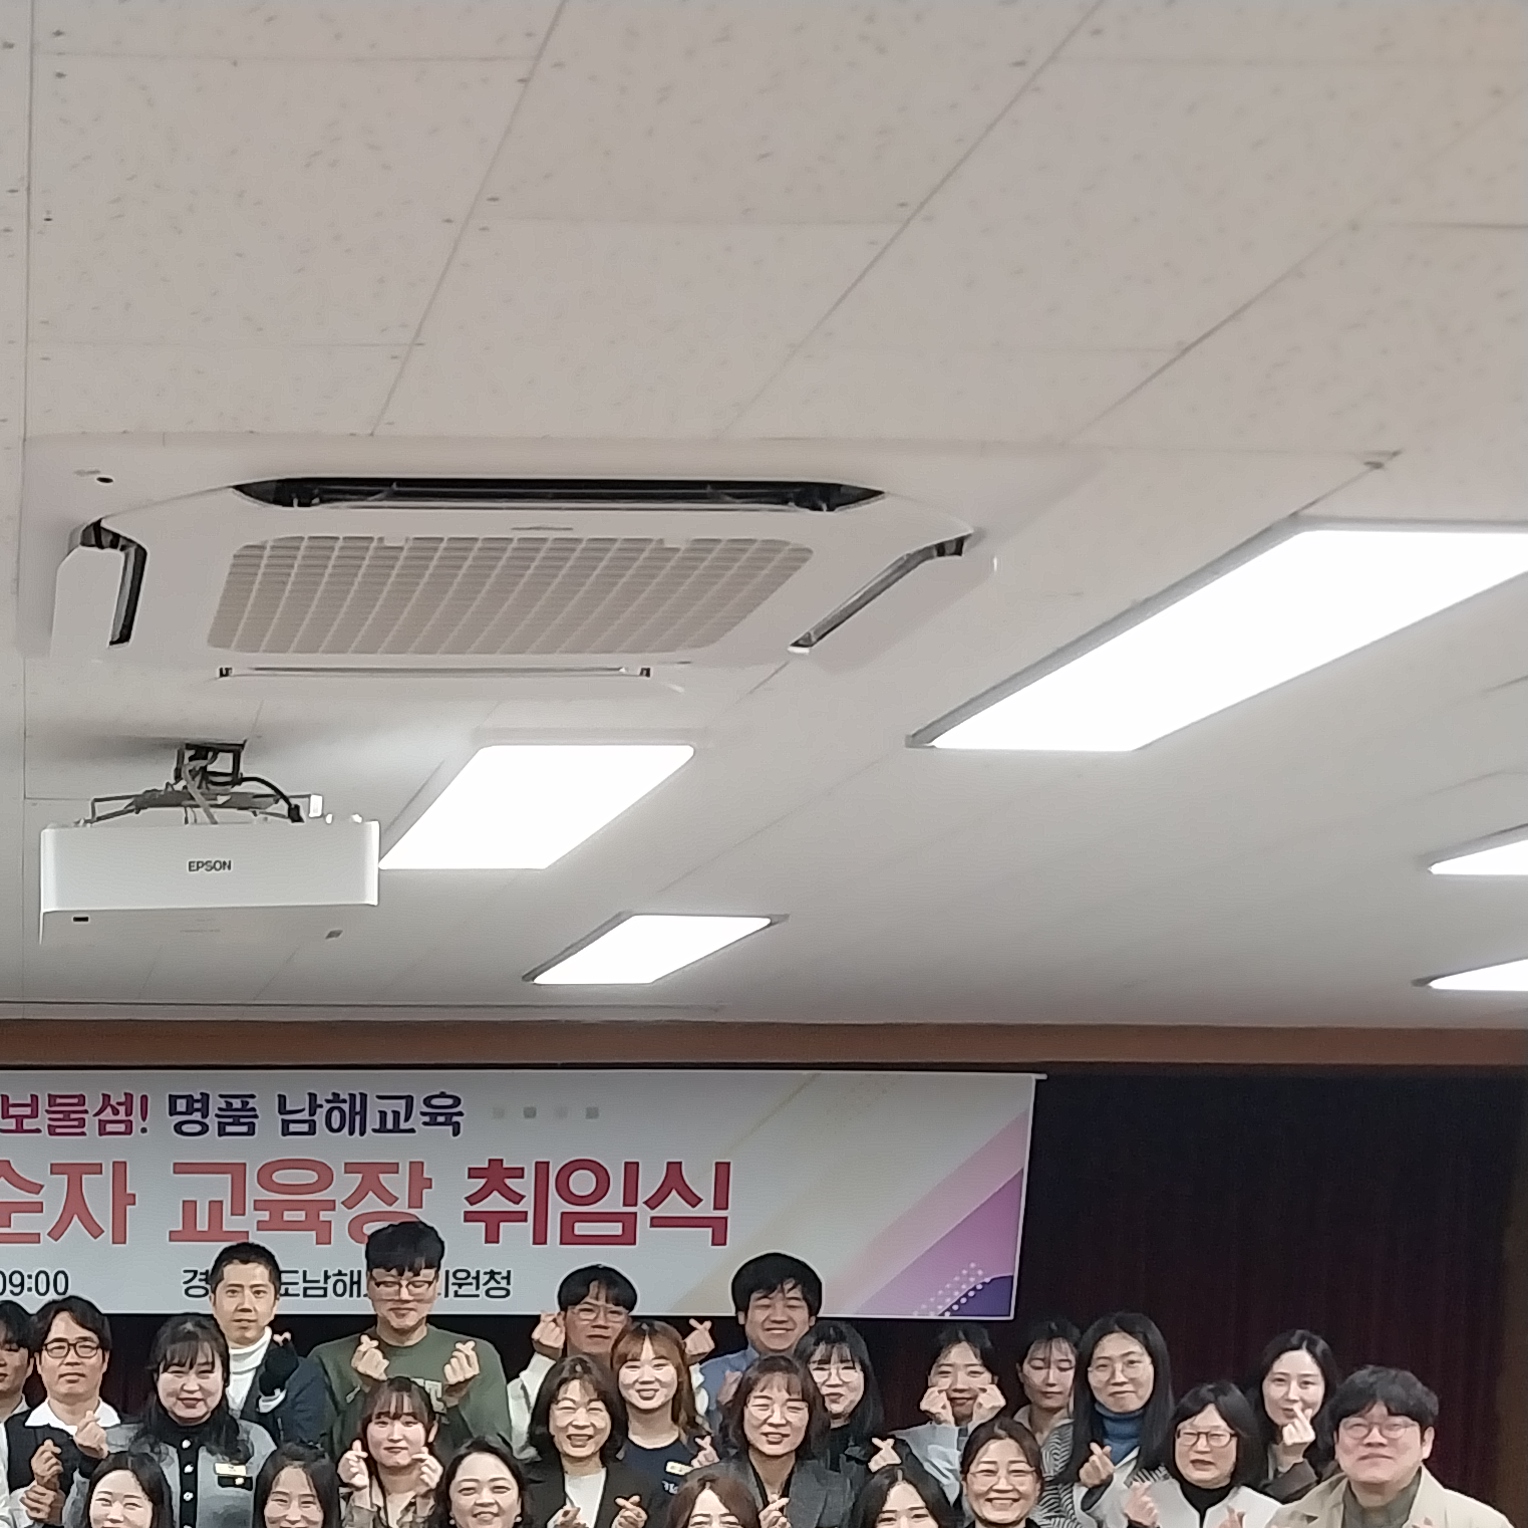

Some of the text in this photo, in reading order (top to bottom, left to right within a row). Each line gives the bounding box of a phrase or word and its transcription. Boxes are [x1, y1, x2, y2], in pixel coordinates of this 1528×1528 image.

[188, 859, 232, 873] EPSON
[167, 1090, 260, 1138] 명품
[276, 1090, 466, 1138] 남해교육
[168, 1158, 434, 1246] 교육장
[462, 1157, 732, 1247] 취임식
